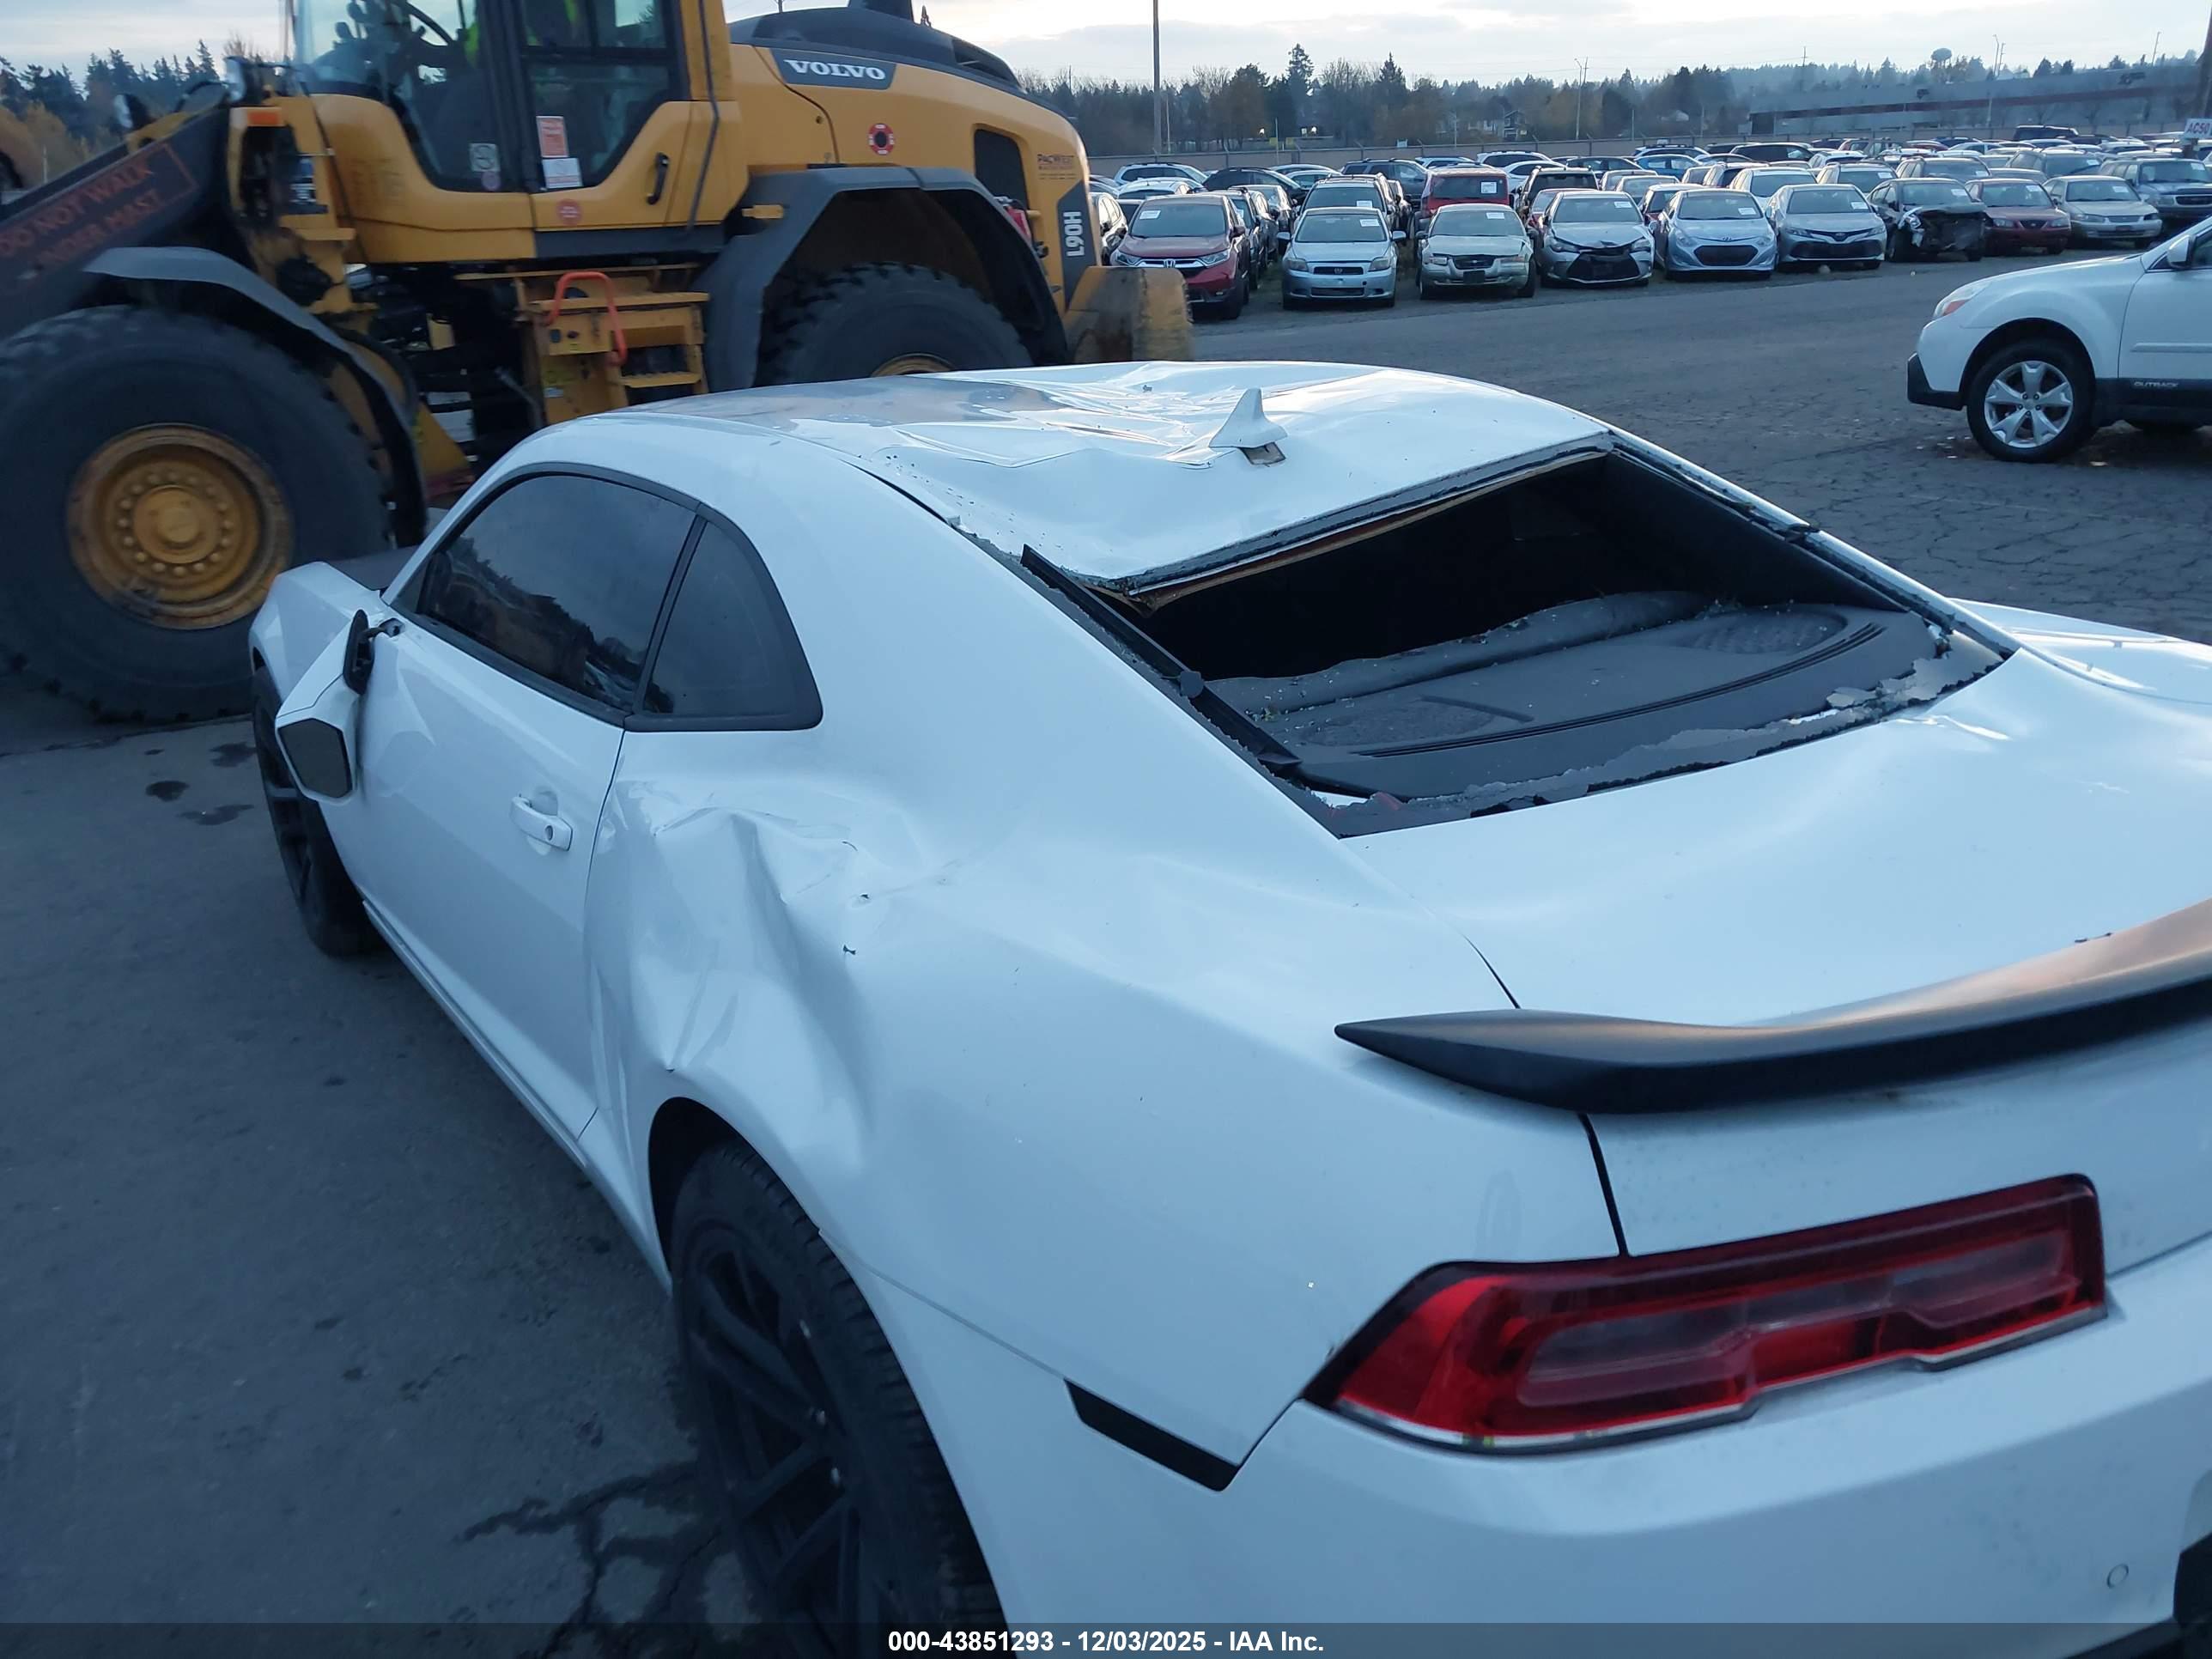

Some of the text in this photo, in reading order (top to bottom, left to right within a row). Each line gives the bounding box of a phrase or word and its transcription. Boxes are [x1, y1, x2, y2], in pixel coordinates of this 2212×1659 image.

[784, 59, 886, 80] VOLVO
[33, 191, 86, 234] NOT
[82, 160, 153, 204] WALK
[1063, 211, 1085, 257] L90H
